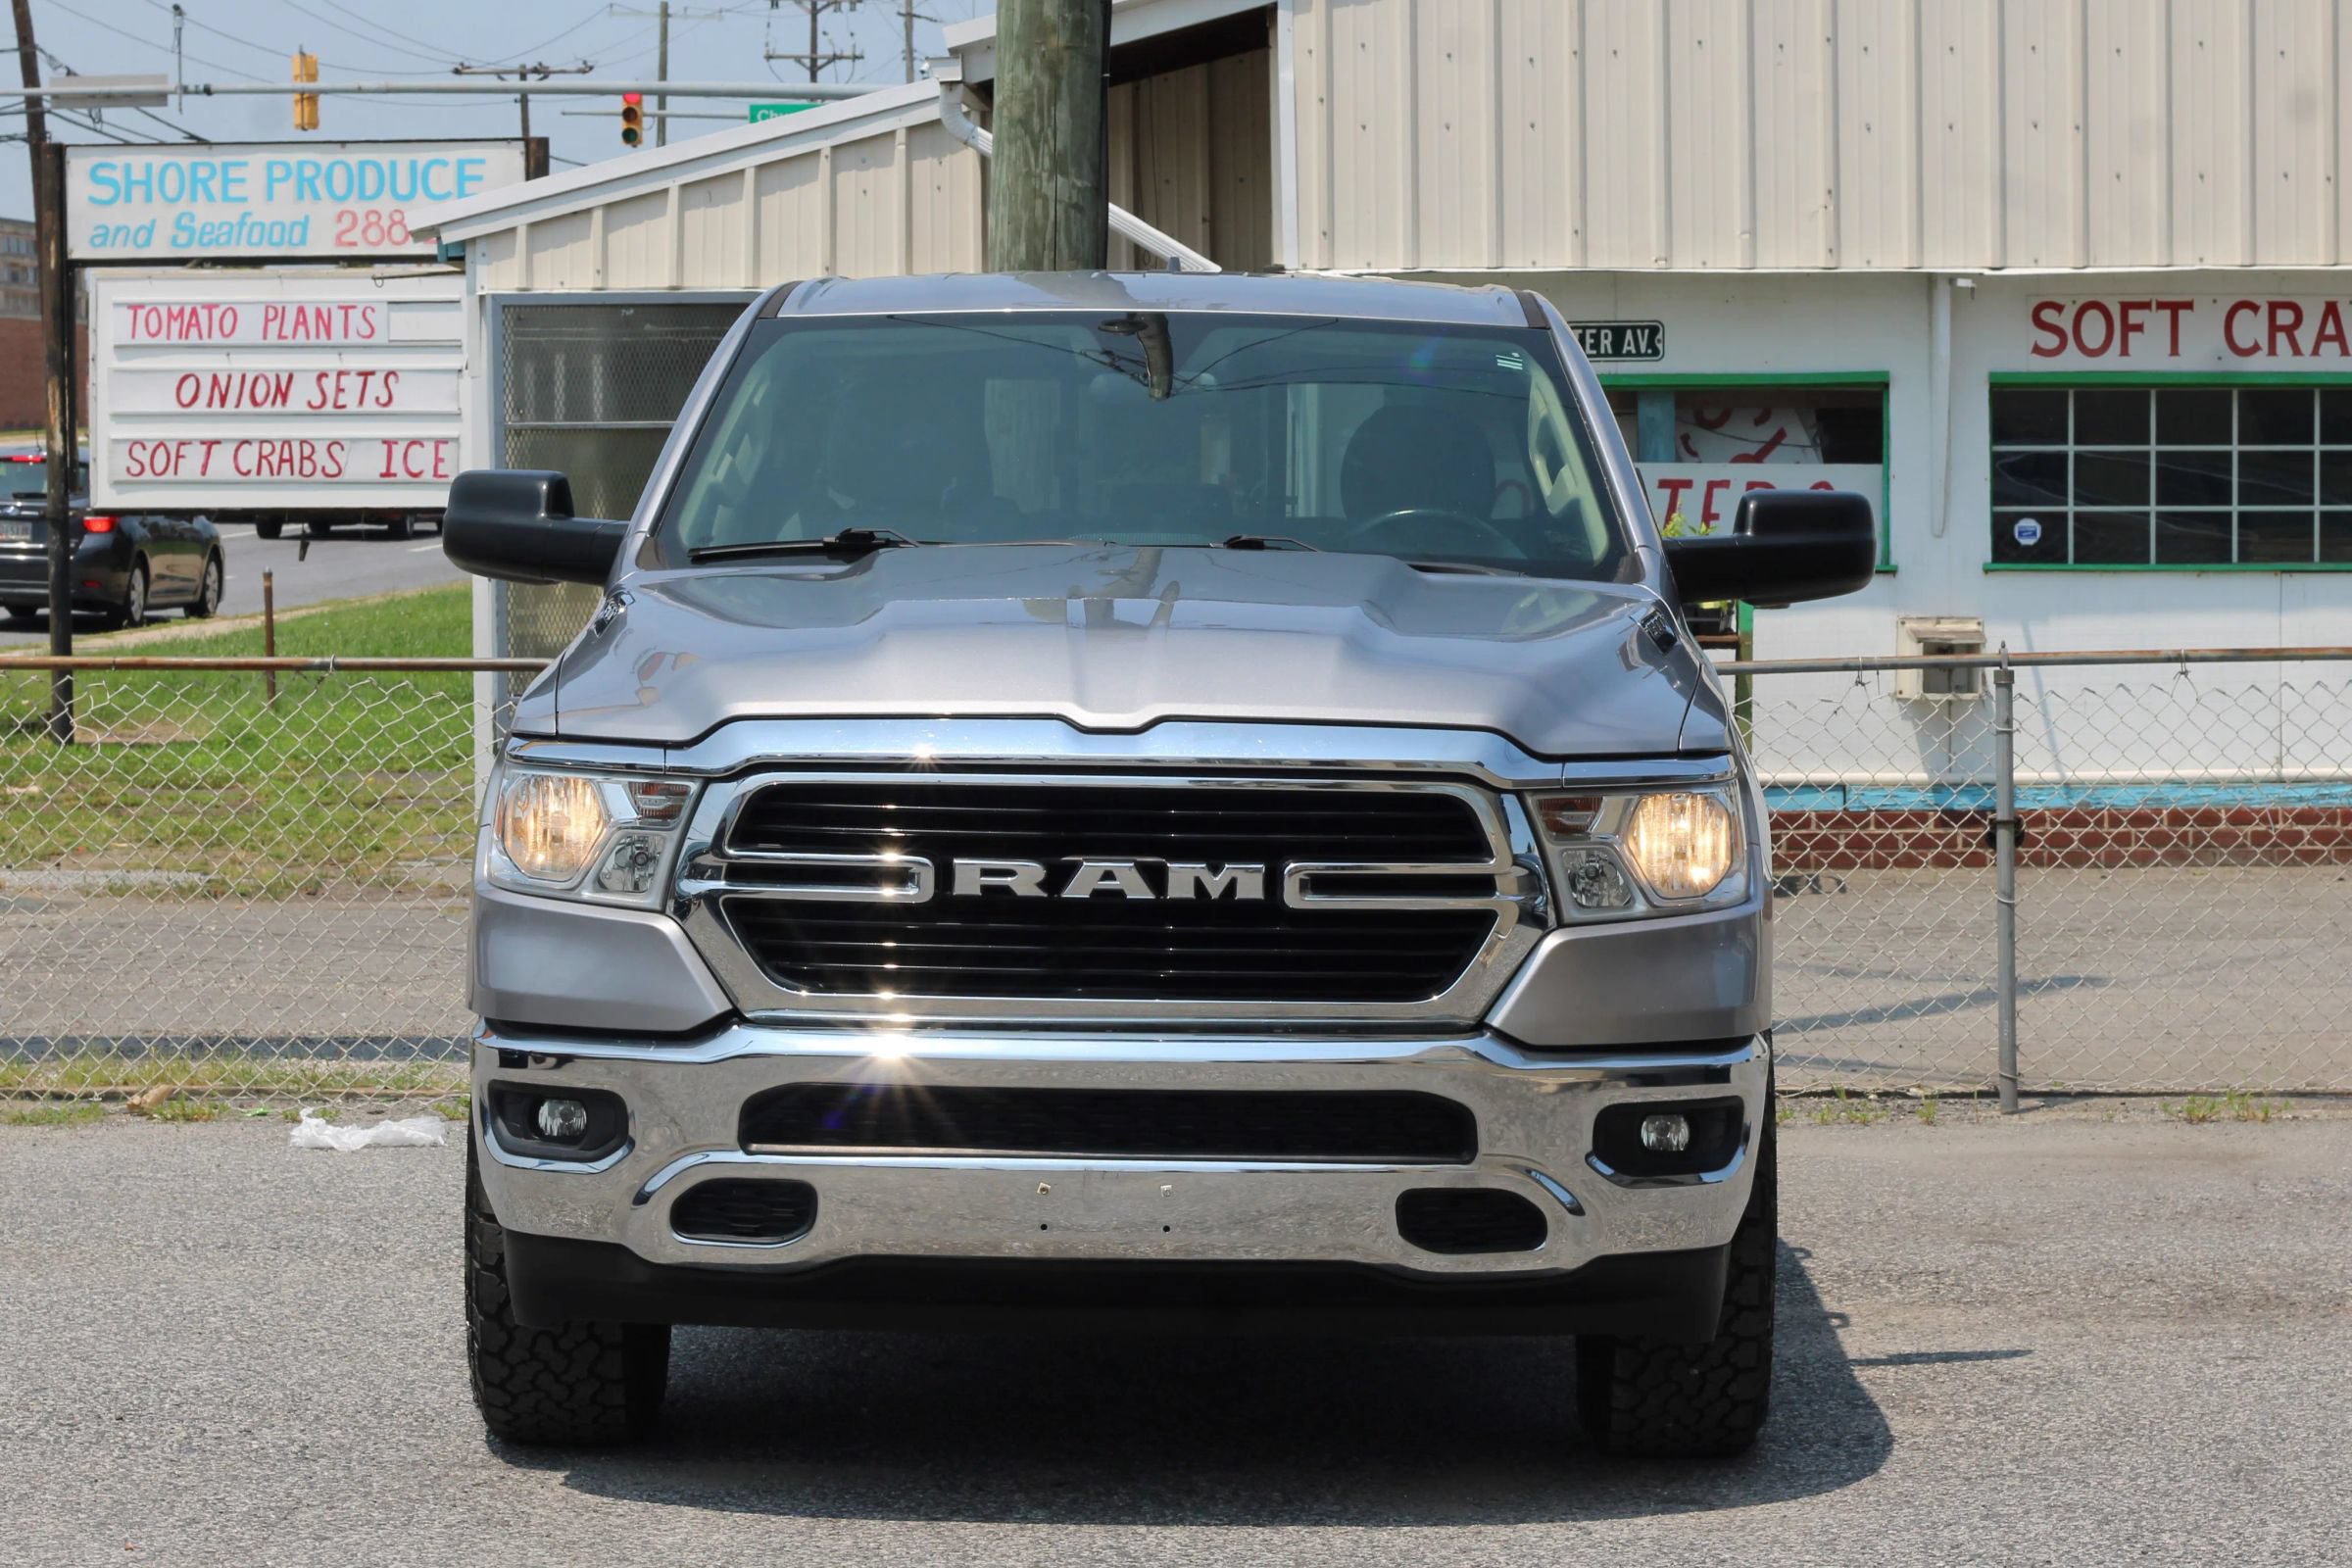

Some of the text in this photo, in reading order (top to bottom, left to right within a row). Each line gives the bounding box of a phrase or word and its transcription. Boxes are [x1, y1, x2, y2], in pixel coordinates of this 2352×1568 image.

[88, 158, 486, 205] SHORE PRODUCE
[89, 220, 155, 248] and
[171, 212, 310, 248] Seafood
[127, 304, 376, 340] TOMATO PLANTS
[1623, 329, 1652, 354] AV.
[2031, 299, 2352, 358] SOFT CRA
[175, 370, 399, 410] ONION SETS
[125, 440, 451, 479] SOFT CRABS ICE
[952, 858, 1265, 900] RAM
